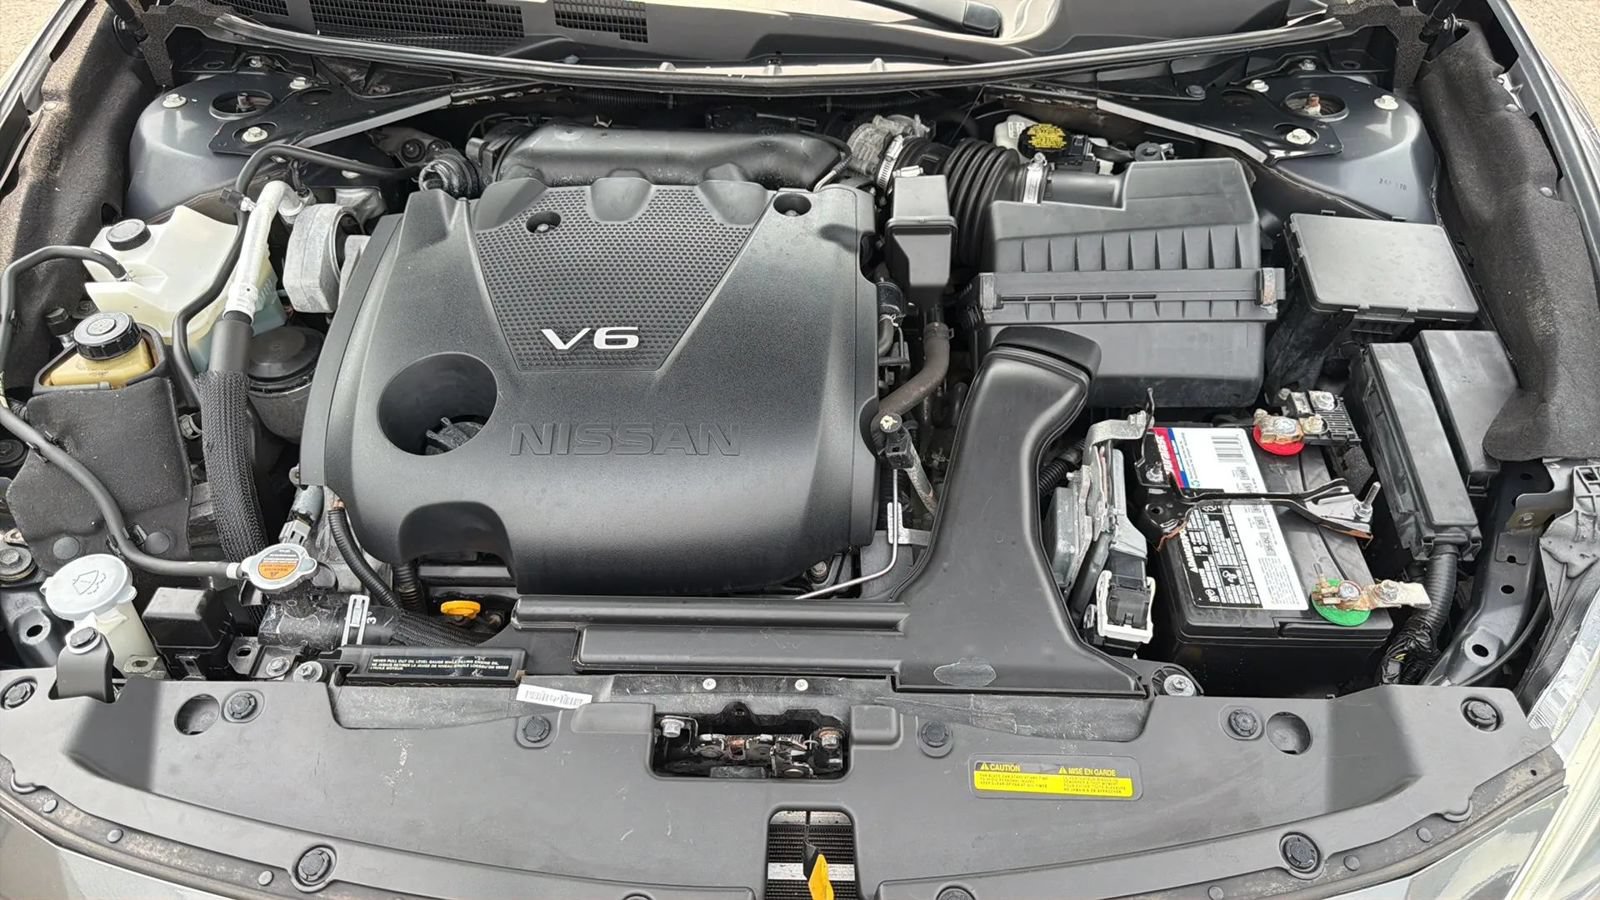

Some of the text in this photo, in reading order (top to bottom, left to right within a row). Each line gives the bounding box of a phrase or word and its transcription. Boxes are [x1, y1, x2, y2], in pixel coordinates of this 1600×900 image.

[541, 327, 640, 350] V6
[510, 422, 741, 456] NISSAN
[990, 763, 1021, 772] CAUTION
[1068, 767, 1116, 777] MISE EN GARDE
